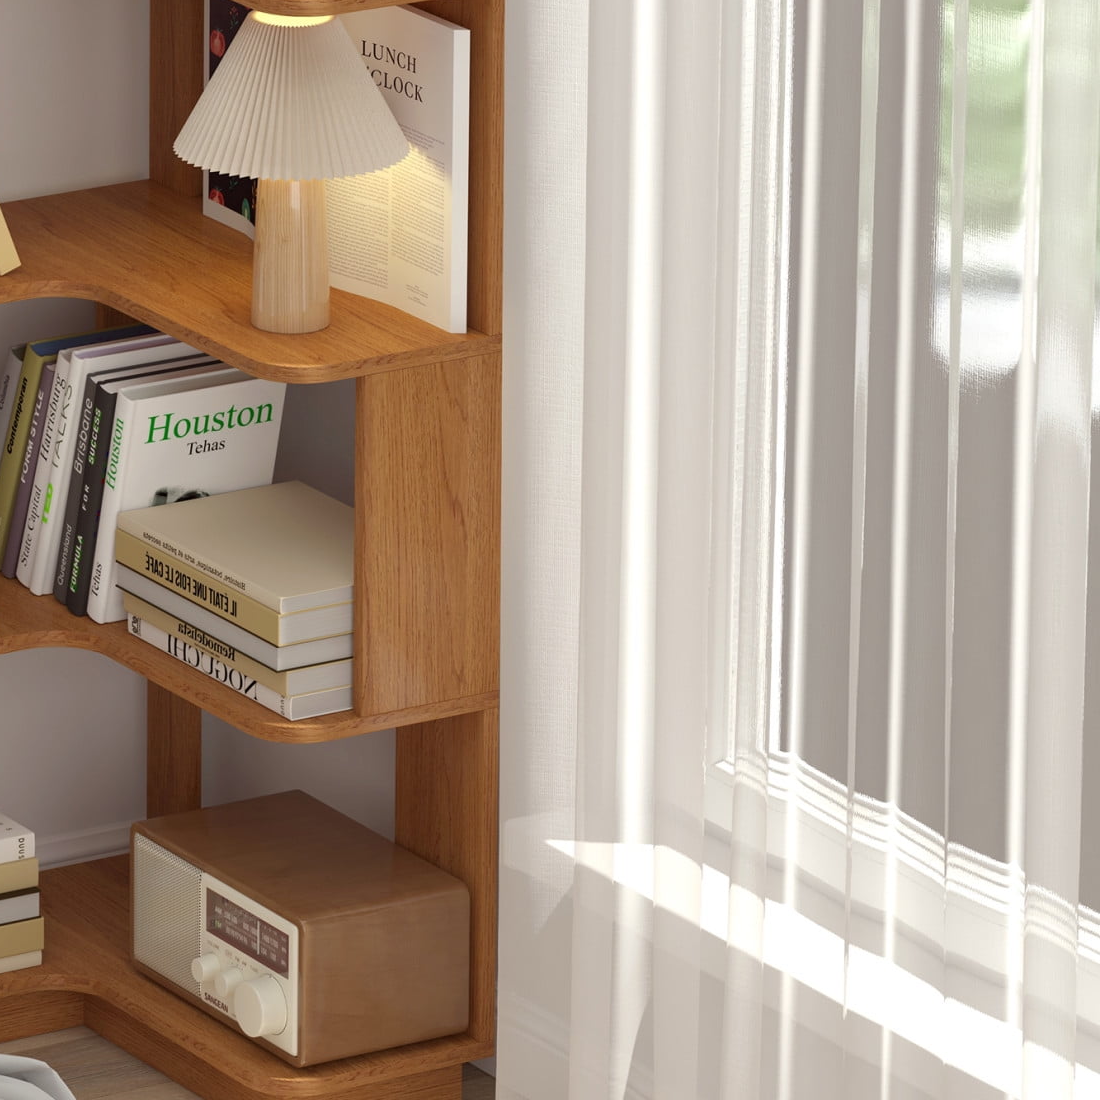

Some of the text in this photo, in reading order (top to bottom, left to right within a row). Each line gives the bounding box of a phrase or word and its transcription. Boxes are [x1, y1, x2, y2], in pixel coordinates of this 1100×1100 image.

[361, 40, 416, 74] LUNCH
[20, 390, 45, 484] FORM STYLE
[41, 373, 67, 462] Harrisburg
[52, 384, 72, 468] TALKS
[74, 397, 93, 474] Brisbane
[105, 418, 124, 491] Houston
[144, 402, 273, 444] Houston
[187, 437, 225, 456] Tehas
[20, 485, 42, 567] State Capital
[69, 408, 102, 594] FORMULA FOR SUCCESS
[57, 524, 72, 586] Queensland
[91, 562, 102, 597] Tehas
